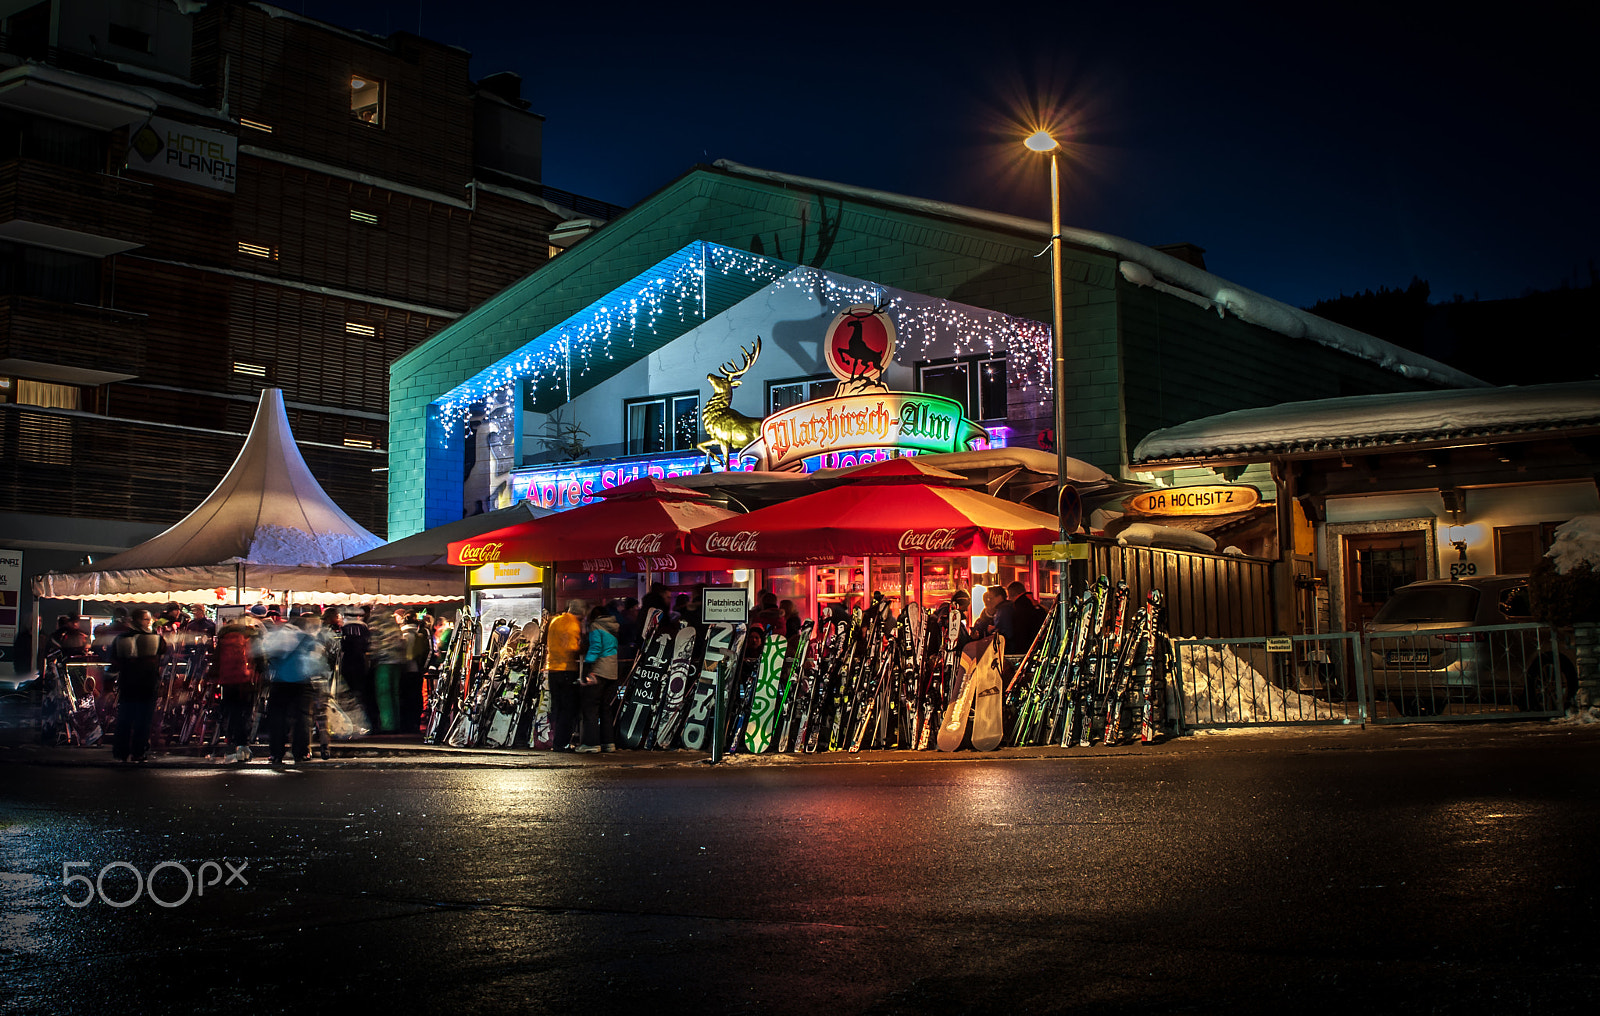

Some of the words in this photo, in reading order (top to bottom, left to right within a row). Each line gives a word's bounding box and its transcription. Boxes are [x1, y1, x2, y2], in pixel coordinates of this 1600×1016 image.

[168, 131, 230, 162] HOTEL
[166, 148, 235, 179] PLANAI
[526, 472, 593, 508] Après
[602, 465, 639, 500] Ski
[1149, 496, 1166, 510] DA
[1171, 491, 1234, 507] HOCHSITZ
[615, 532, 664, 555] Coca-Cola
[706, 531, 760, 552] Coca-Cola
[898, 528, 959, 551] Coca-Cola
[987, 529, 1016, 551] Coca-Cola
[459, 542, 504, 562] Coca-Cola
[1450, 563, 1477, 576] 529
[707, 598, 744, 606] Platzhirsch
[640, 669, 660, 681] BUR
